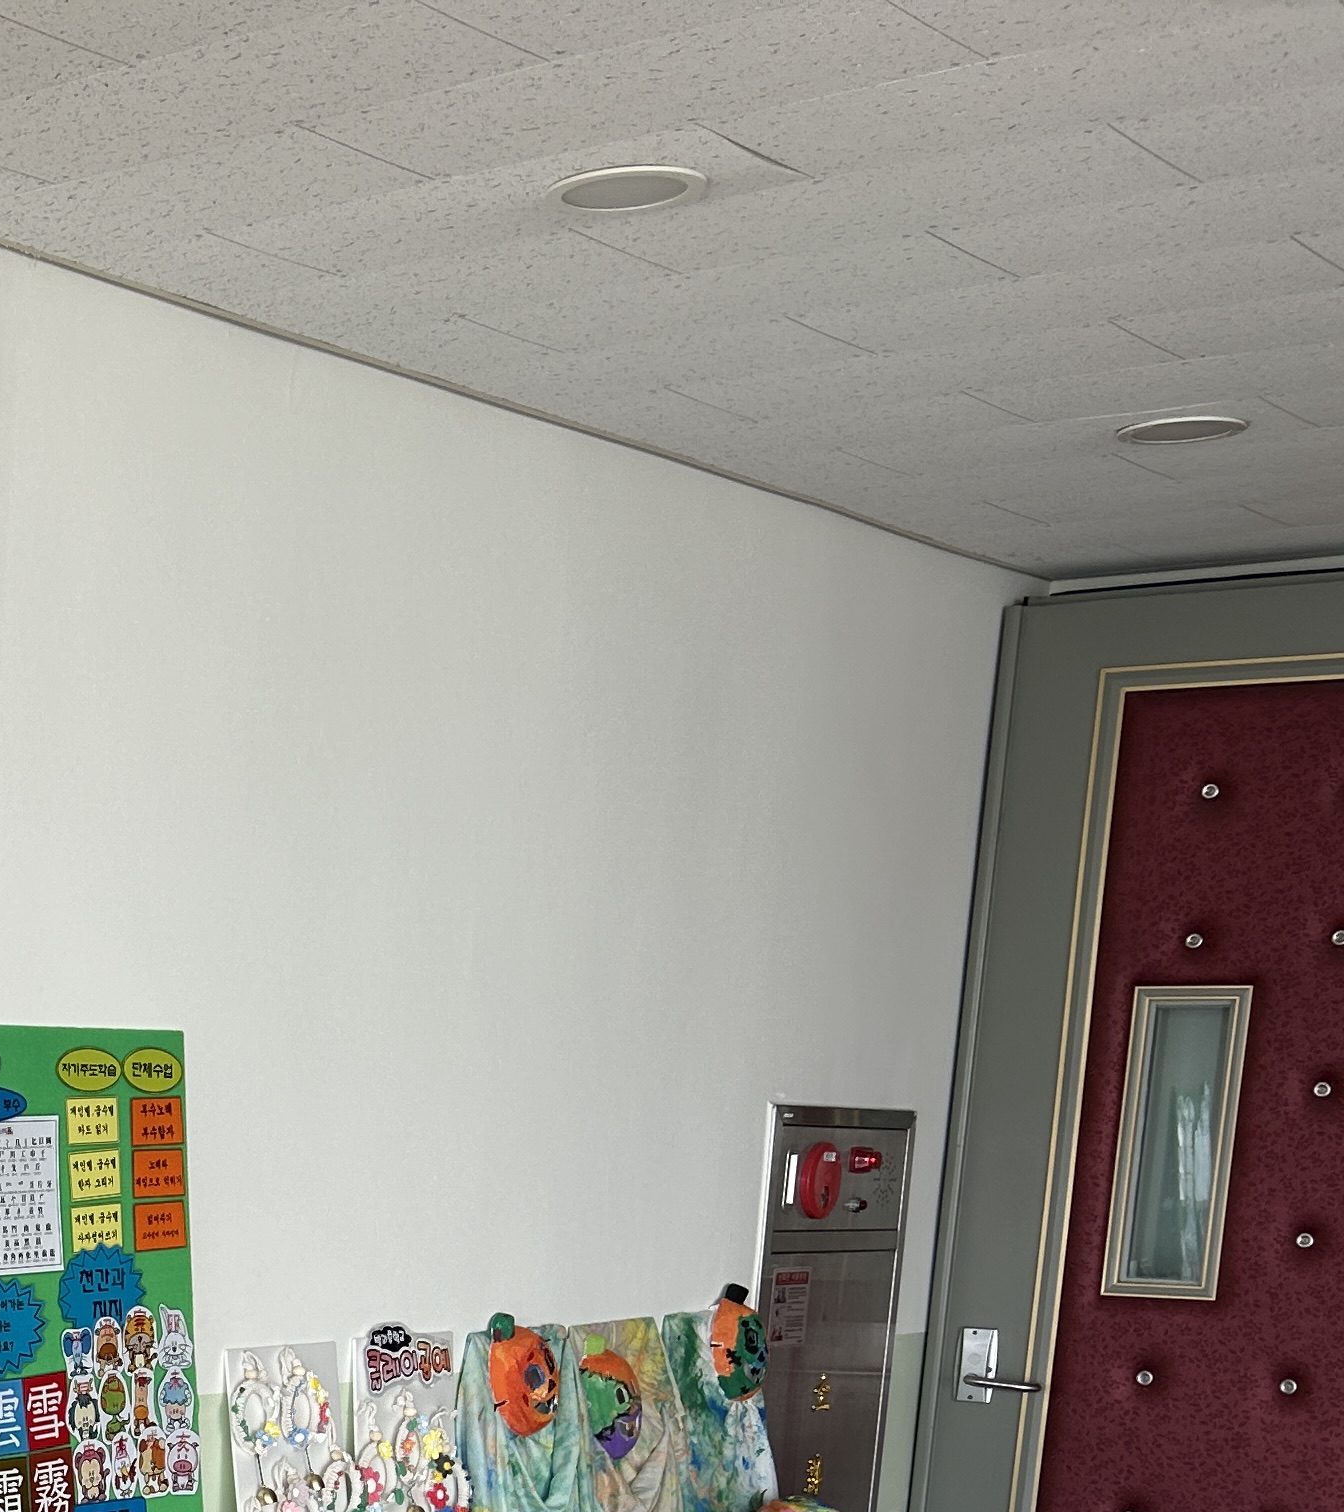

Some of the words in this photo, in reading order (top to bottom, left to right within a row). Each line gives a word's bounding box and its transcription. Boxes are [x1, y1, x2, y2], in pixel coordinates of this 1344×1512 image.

[62, 1062, 116, 1077] 자기주도학습
[132, 1062, 173, 1078] 단체수업
[3, 1099, 20, 1112] 부수
[80, 1268, 125, 1293] 천간과
[367, 1349, 418, 1391] 클레이
[417, 1341, 451, 1381] 공예
[26, 1382, 66, 1442] 雪
